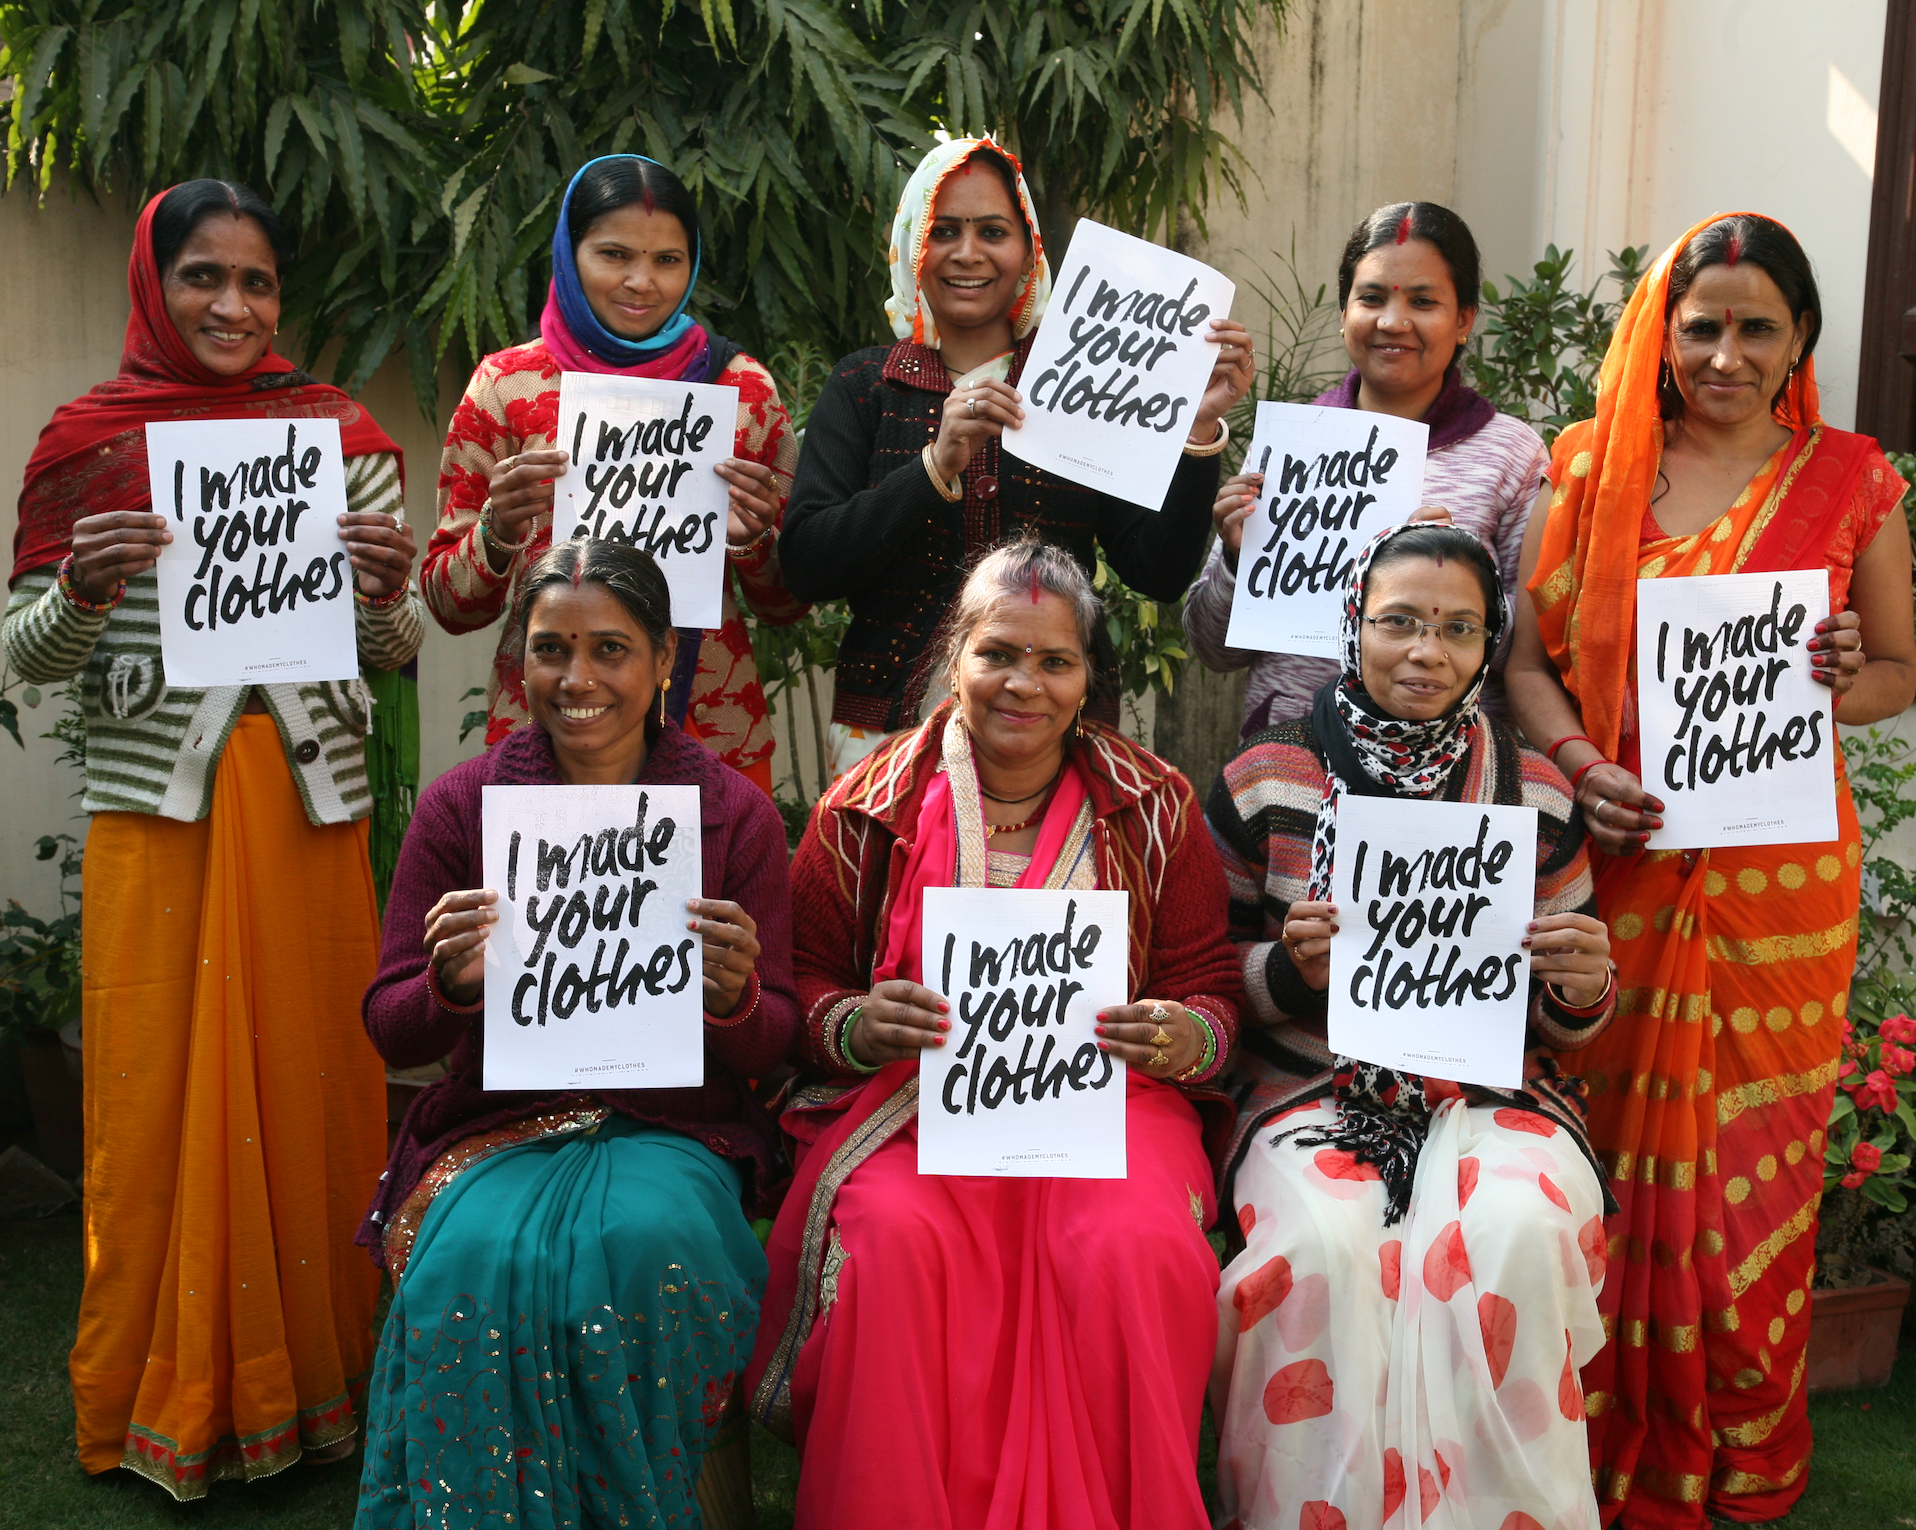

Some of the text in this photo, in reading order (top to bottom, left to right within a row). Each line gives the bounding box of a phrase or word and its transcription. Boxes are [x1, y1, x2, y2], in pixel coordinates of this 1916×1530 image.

[1063, 265, 1211, 337] I made
[1054, 315, 1178, 372] your
[572, 391, 714, 467] I made
[1030, 360, 1188, 433] clothes
[174, 423, 322, 522] I made
[580, 458, 694, 521] your
[1058, 453, 1115, 477] #WHOMADEMYCLOTHES
[1257, 424, 1399, 500] I made
[193, 497, 311, 580] your
[1262, 490, 1378, 553] your
[184, 551, 345, 631] clothes
[1247, 535, 1356, 600] cloth
[244, 659, 307, 671] #WHOMADEMYCLOTHES
[1290, 634, 1339, 642] #WHOMADEMYCLOT
[1657, 580, 1807, 683] I made
[1673, 657, 1791, 740] your
[1664, 710, 1824, 792] clothes
[507, 790, 677, 902] I made
[1352, 813, 1515, 903] I made
[1722, 819, 1785, 831] #WHOMADEMYCLOTHES
[523, 876, 660, 969] your
[941, 898, 1103, 997] I made
[1362, 892, 1493, 962] your
[511, 937, 696, 1028] clothes
[1349, 942, 1523, 1012] clothes
[955, 978, 1085, 1059] your
[574, 1061, 646, 1073] #WHOMADEMYCLOTHES
[941, 1033, 1114, 1116] clothes
[1402, 1052, 1467, 1064] #WHOMADEMYCLOTHES
[1001, 1152, 1069, 1161] #WHOMADEMYCLOTHES
